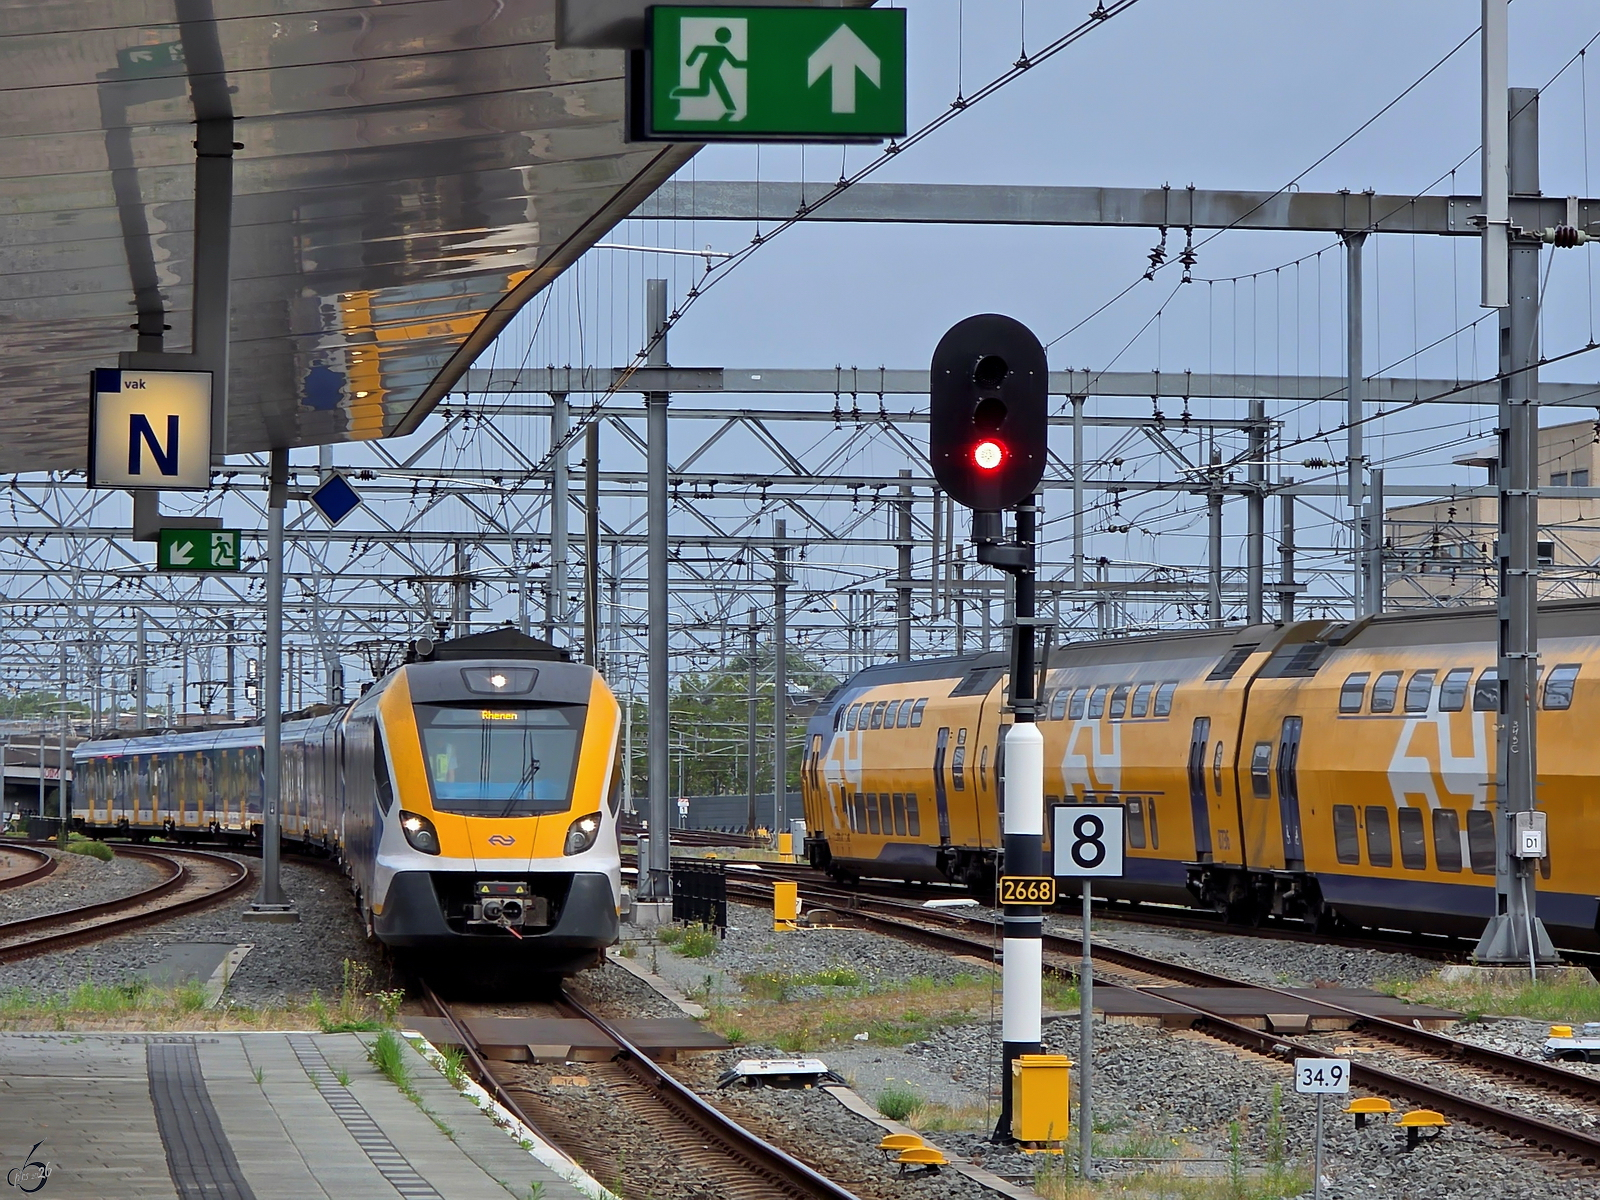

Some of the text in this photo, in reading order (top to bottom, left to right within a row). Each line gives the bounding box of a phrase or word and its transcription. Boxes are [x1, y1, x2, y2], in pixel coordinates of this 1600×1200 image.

[124, 379, 146, 390] vak
[128, 413, 180, 476] N
[481, 709, 518, 720] Rhenen
[1071, 813, 1106, 869] 8
[1526, 838, 1538, 849] D1
[1004, 881, 1050, 900] 2668
[1302, 1065, 1343, 1087] 34.9
